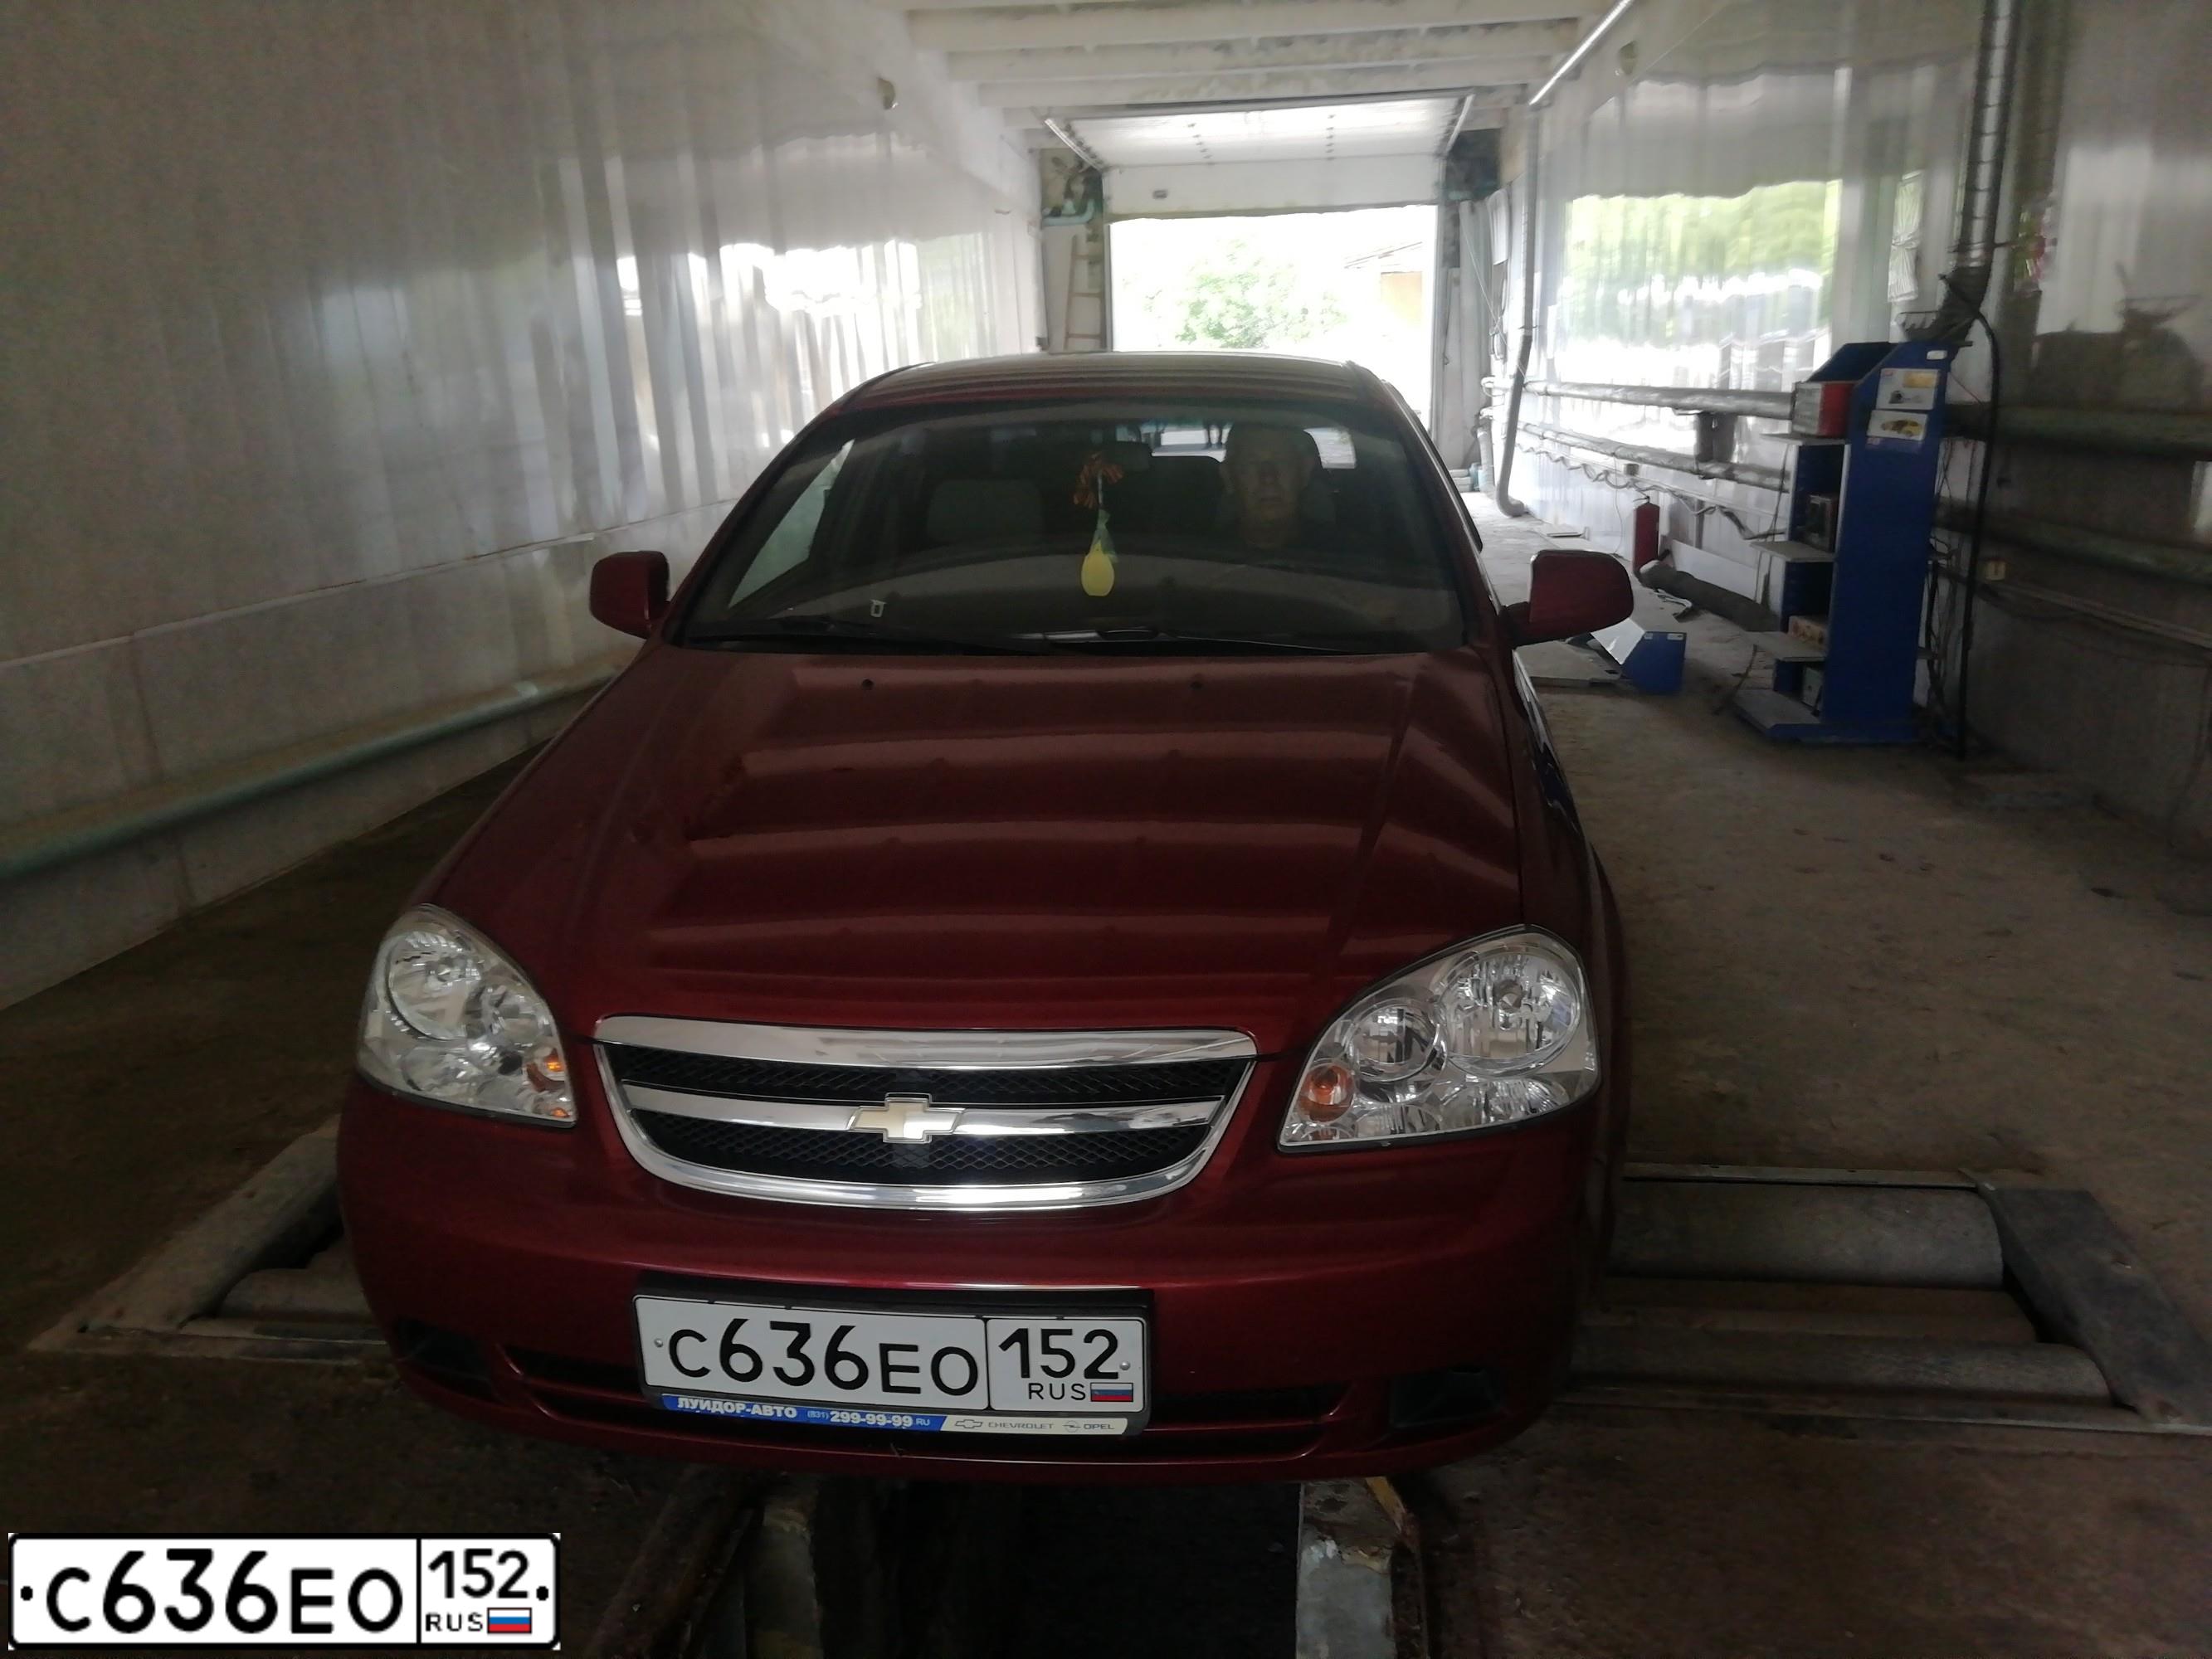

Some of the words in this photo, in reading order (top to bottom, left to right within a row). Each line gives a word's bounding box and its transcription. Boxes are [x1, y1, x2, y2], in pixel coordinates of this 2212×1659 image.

[998, 1327, 1119, 1379] 152
[1028, 1382, 1086, 1401] RUS
[677, 1397, 798, 1418] ЛУИДОР-АВТО
[807, 1410, 829, 1420] (831)
[830, 1411, 913, 1428] 299-99-99
[988, 1421, 1055, 1430] CHEVROLET
